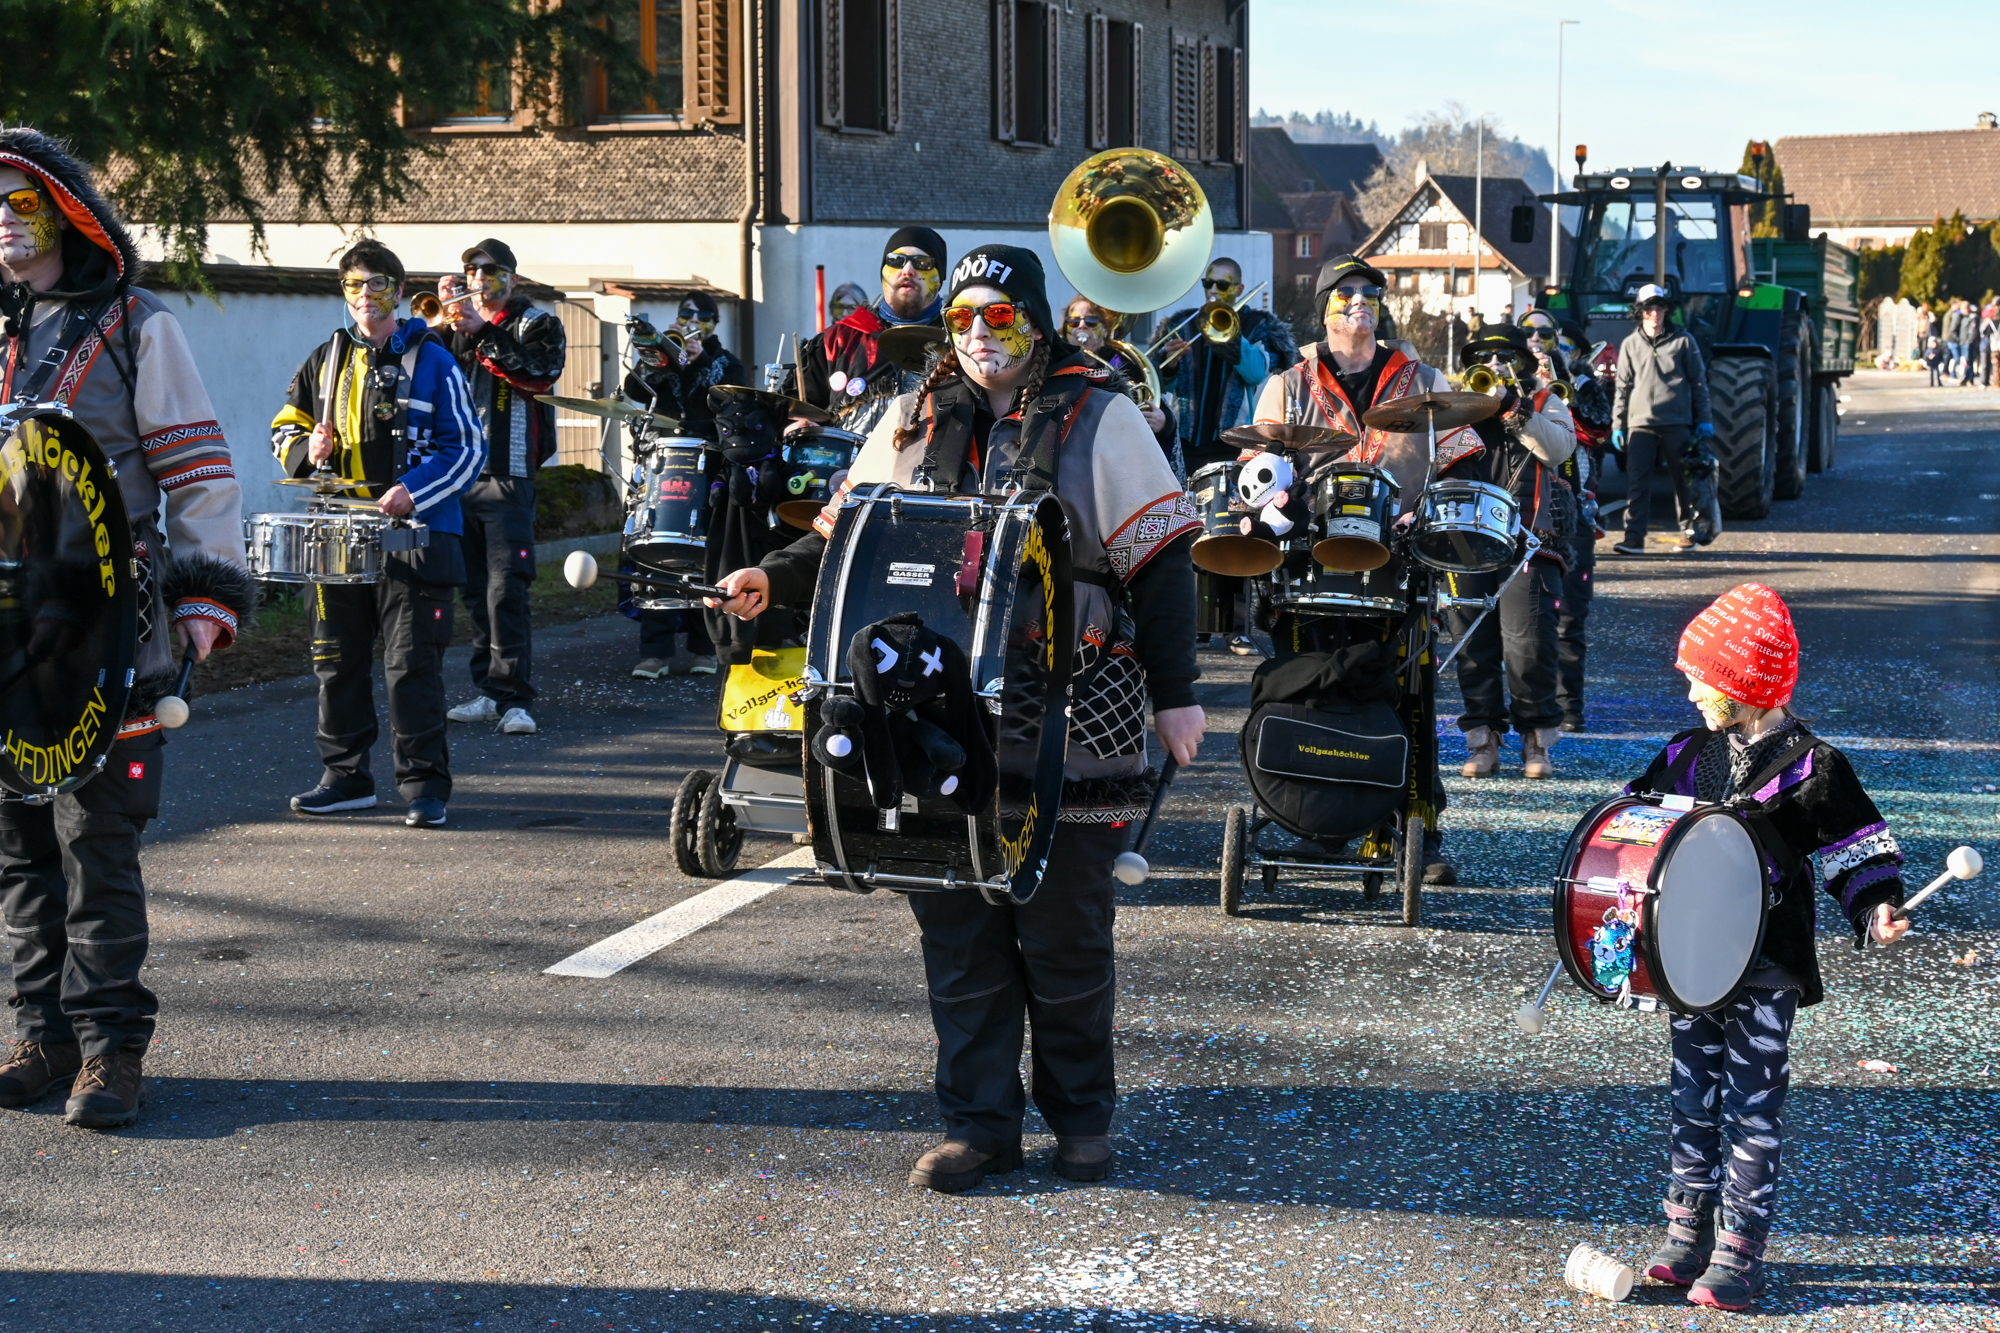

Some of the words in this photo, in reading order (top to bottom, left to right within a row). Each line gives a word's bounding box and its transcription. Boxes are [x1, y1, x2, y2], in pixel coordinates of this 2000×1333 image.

[952, 254, 1012, 291] DÖÖFI
[1724, 639, 1750, 659] SUISSE
[1744, 664, 1783, 684] SCHWEIZ
[1717, 681, 1748, 700] SCHWEIZ
[1298, 744, 1371, 760] Vollgashöckler
